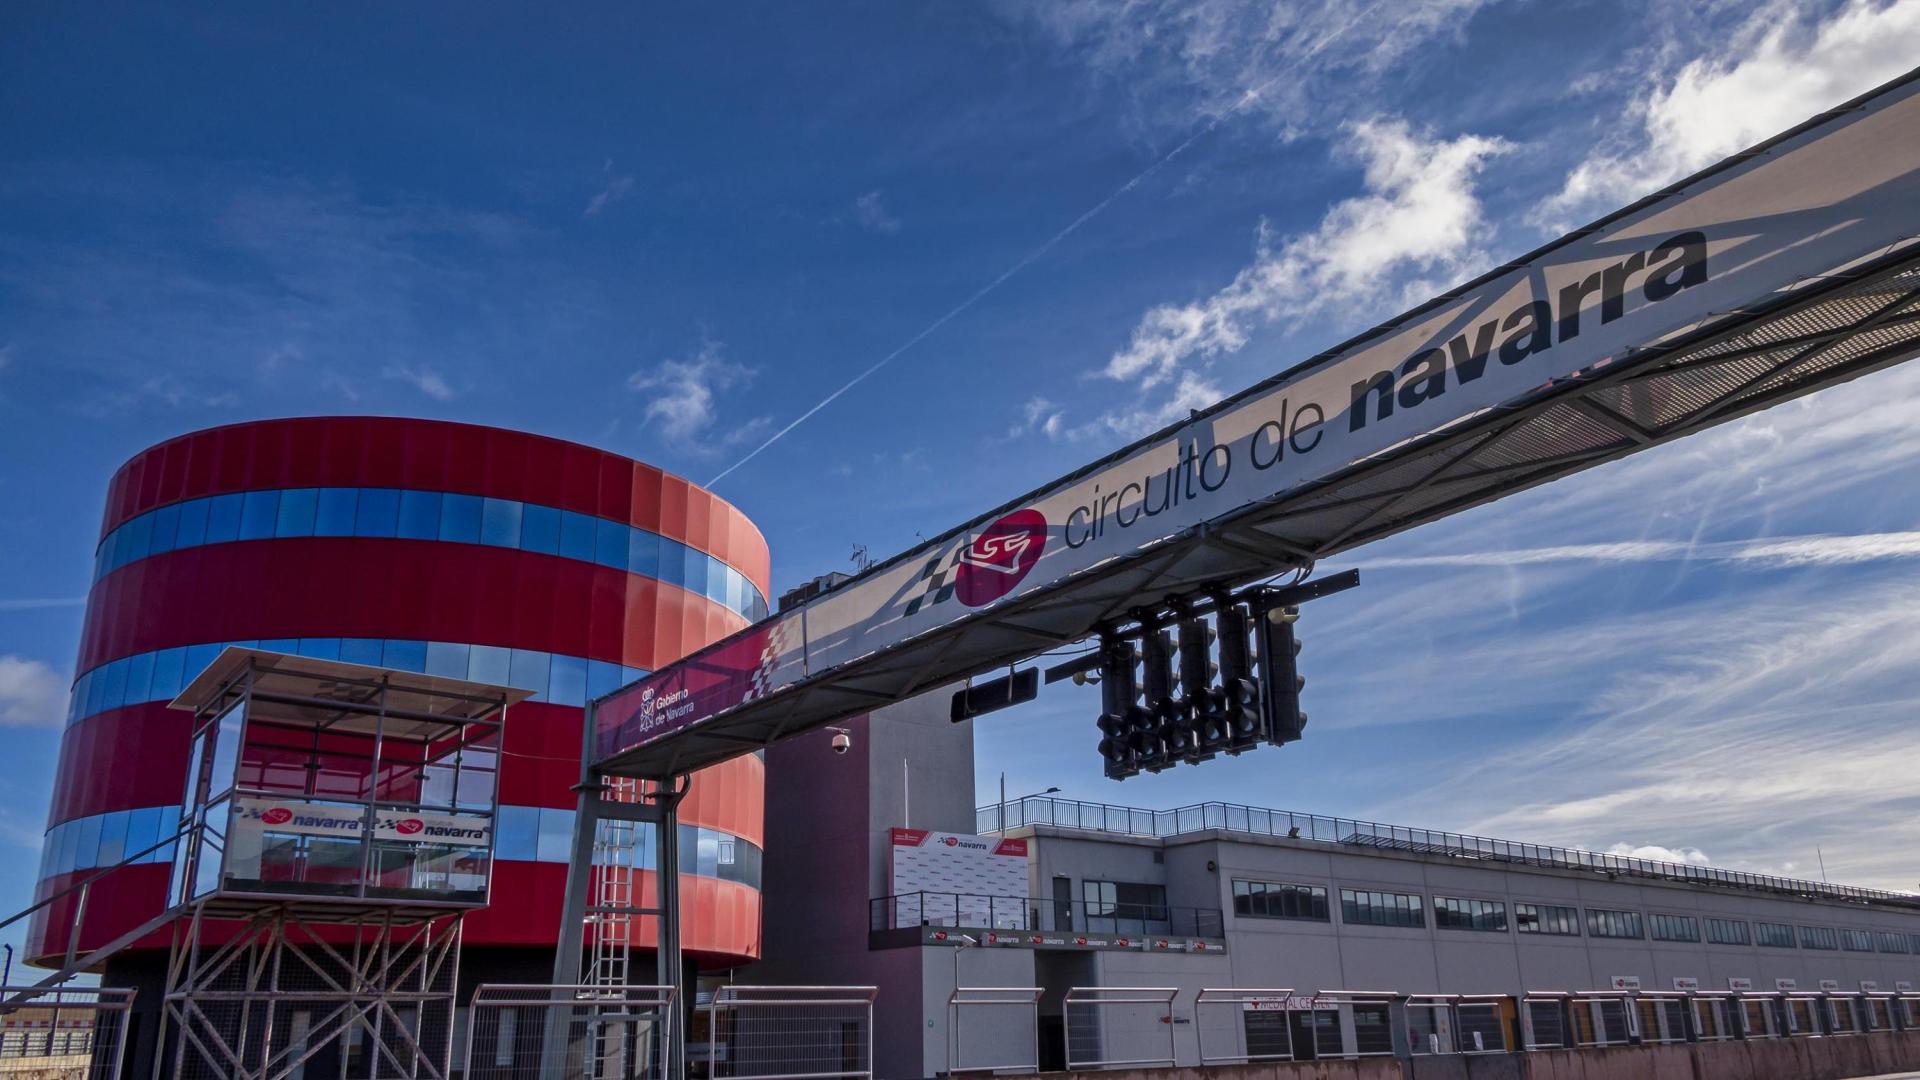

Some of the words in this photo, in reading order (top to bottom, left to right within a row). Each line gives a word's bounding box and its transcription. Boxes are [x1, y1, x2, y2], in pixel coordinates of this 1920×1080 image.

[1064, 437, 1232, 549] circuito
[1250, 398, 1325, 471] de
[1349, 230, 1709, 433] navarra
[656, 688, 689, 710] Gobierno
[655, 713, 665, 725] de
[666, 702, 695, 722] Navarra
[292, 815, 359, 830] navarra
[424, 826, 484, 839] navarra
[958, 841, 987, 850] navarra
[1260, 997, 1298, 1009] MEDIAL
